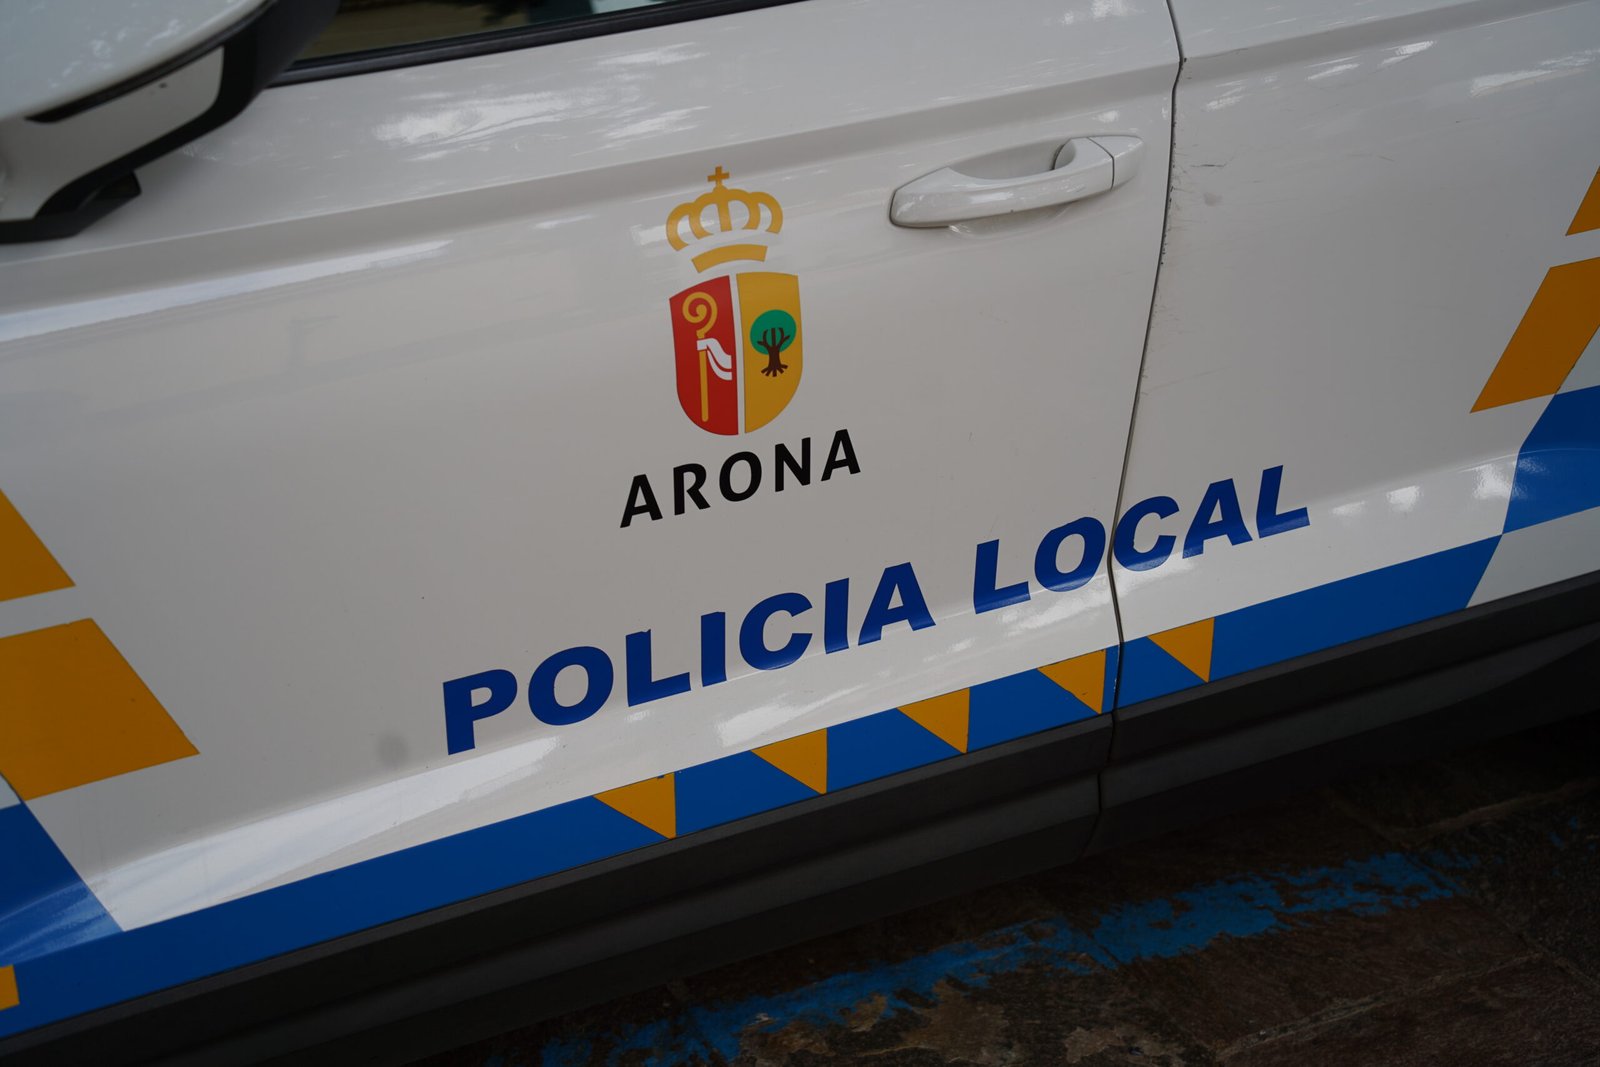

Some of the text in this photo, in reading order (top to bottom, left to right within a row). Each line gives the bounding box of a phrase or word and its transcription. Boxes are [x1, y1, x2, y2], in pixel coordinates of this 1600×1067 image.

[620, 429, 861, 529] ARONA
[443, 465, 1310, 756] POLICIA LOCAL
